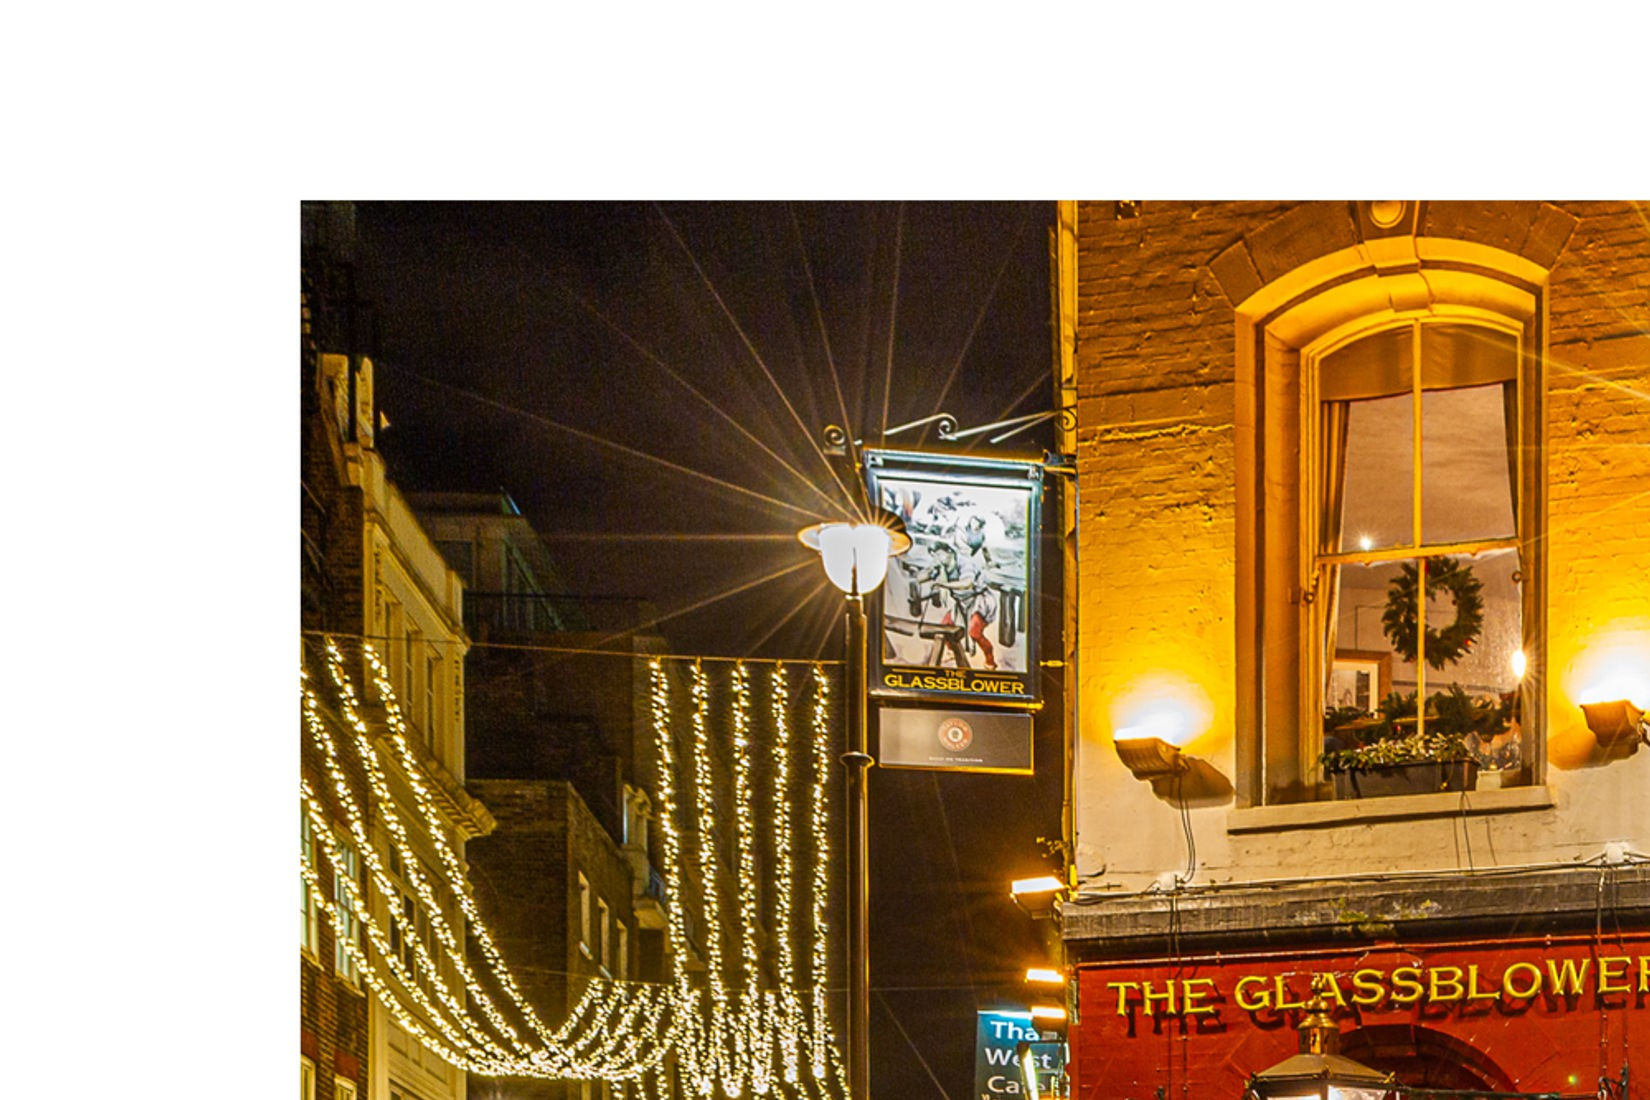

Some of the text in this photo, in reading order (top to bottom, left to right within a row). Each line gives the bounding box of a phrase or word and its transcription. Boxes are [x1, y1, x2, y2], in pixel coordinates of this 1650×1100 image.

[884, 674, 1025, 694] GLASSBLOWER
[944, 670, 967, 678] THE
[1107, 978, 1215, 1016] THE
[990, 1020, 1041, 1041] Tha
